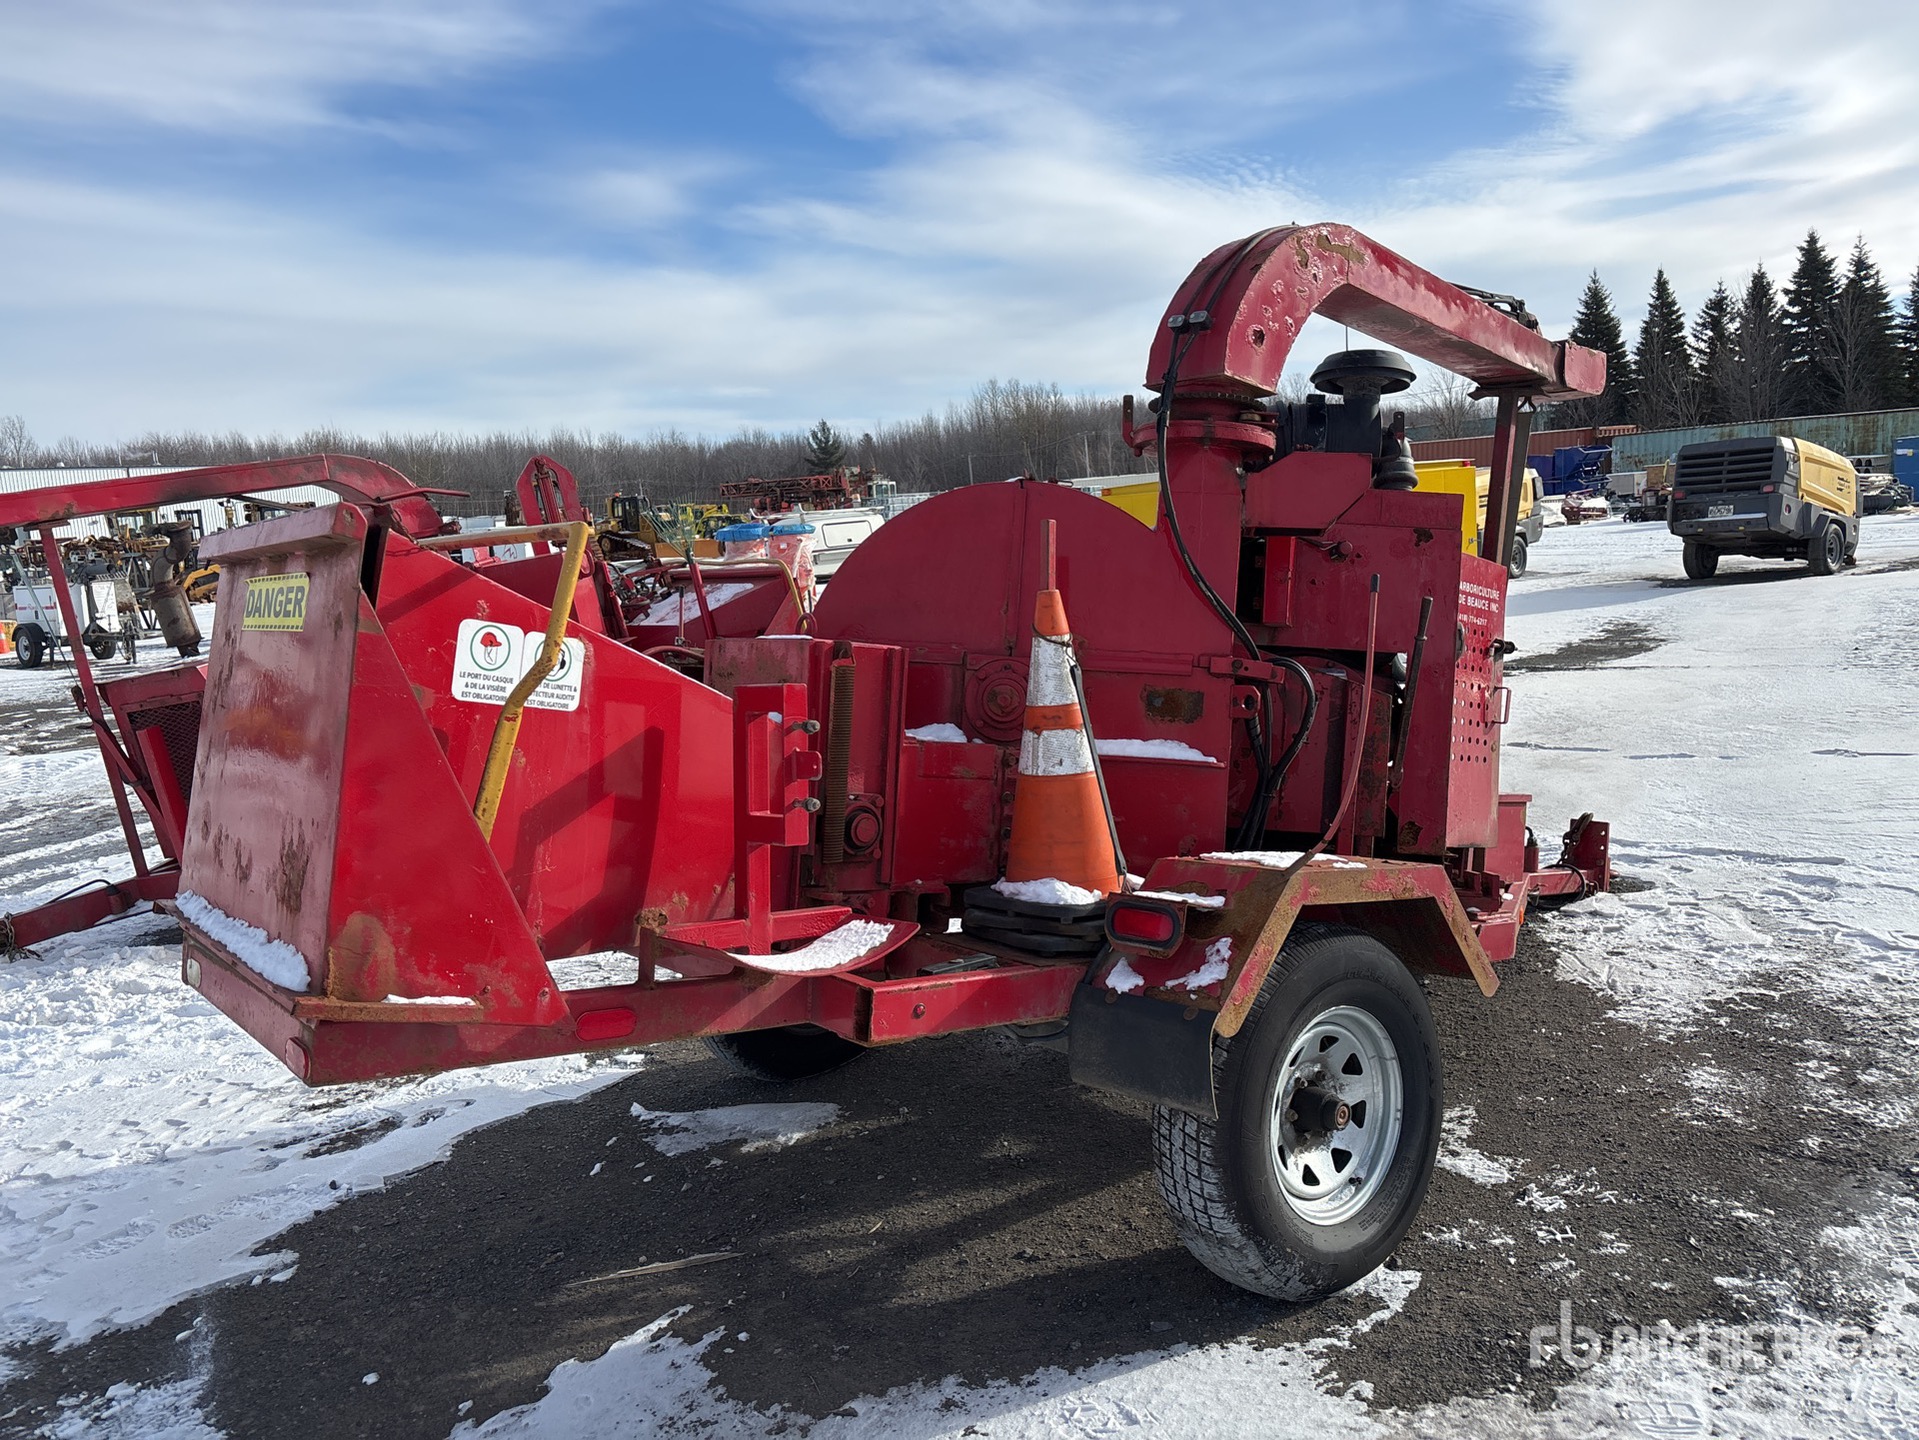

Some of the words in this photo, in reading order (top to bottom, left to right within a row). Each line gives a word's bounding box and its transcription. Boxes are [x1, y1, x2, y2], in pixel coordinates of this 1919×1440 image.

[1460, 581, 1500, 601] ARBORICULTURE
[245, 585, 306, 619] DANGER
[1458, 594, 1466, 605] DE
[1467, 596, 1489, 611] BEAUCE
[1490, 602, 1499, 613] INC
[459, 671, 466, 679] LE
[466, 671, 482, 681] PORT
[482, 674, 492, 682] DU
[491, 675, 514, 685] CASQUE
[461, 690, 472, 698] EST
[464, 681, 469, 689] &
[470, 682, 478, 690] DE
[478, 683, 486, 691] LA
[486, 684, 507, 694] VISIÈRE
[543, 682, 550, 690] DE
[550, 683, 573, 693] LUNETTE
[573, 685, 578, 693] &
[555, 693, 575, 702] AUDITIF
[536, 700, 570, 710] OBLIGATOIRE
